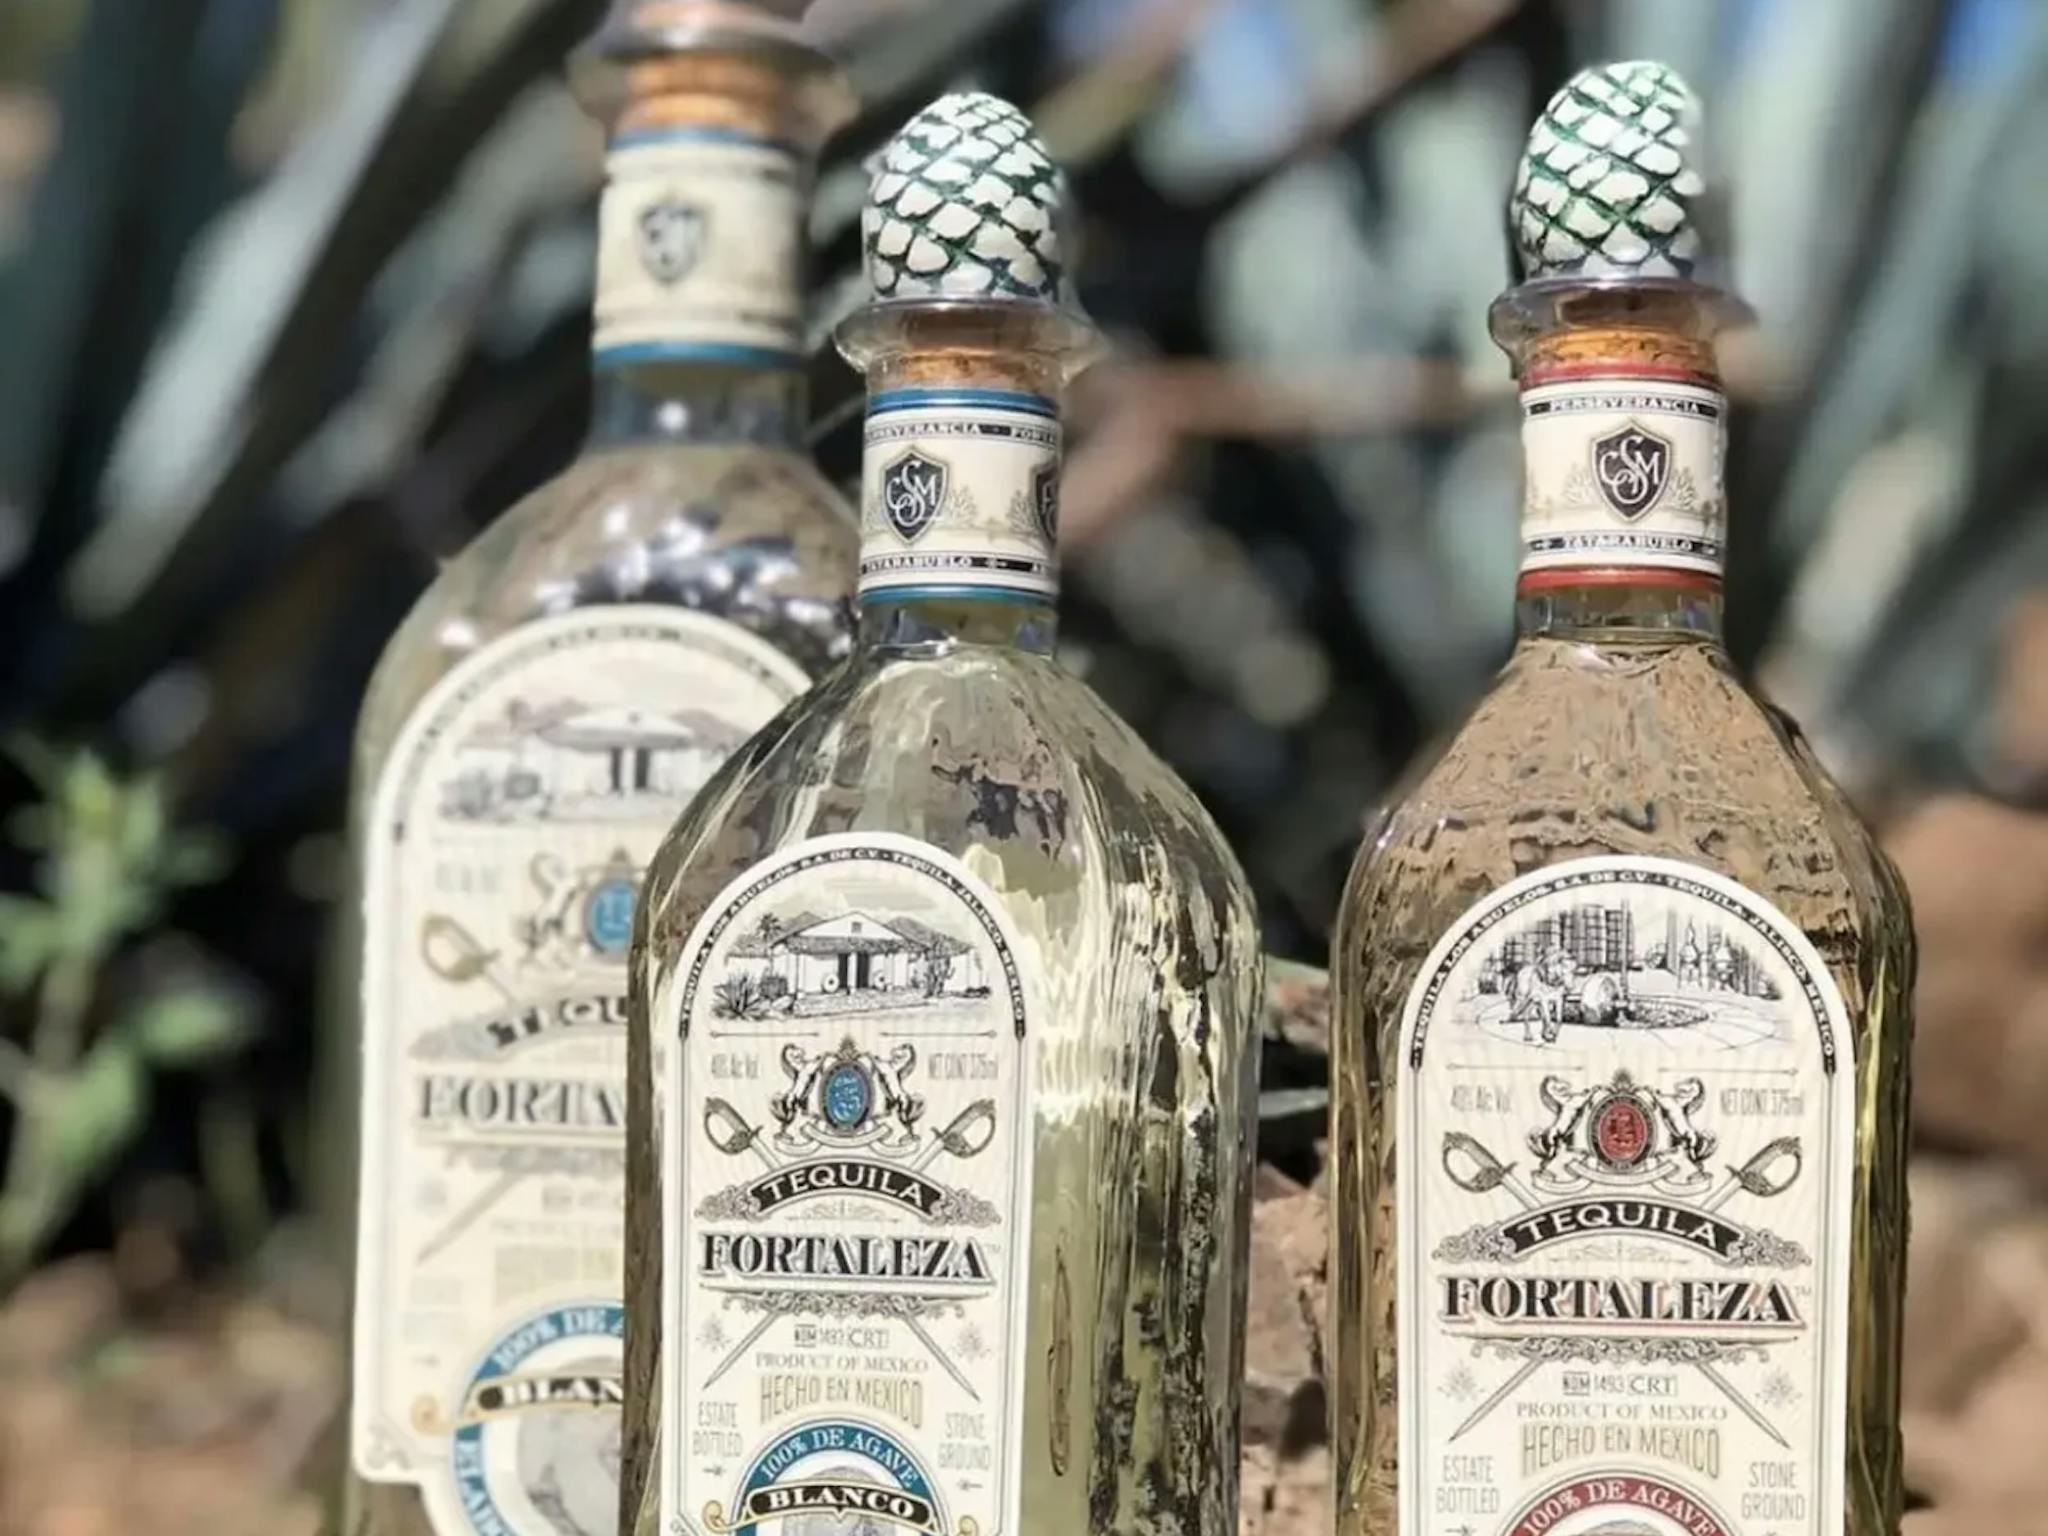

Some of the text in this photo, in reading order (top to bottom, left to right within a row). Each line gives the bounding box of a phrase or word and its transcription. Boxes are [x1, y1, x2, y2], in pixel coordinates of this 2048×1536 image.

[1414, 971, 1447, 1051] TEQUILA
[1444, 938, 1471, 969] LOS
[1589, 870, 1617, 884] DE
[763, 1164, 924, 1207] TEQUILA
[1517, 1203, 1719, 1252] TEQUILA
[701, 1233, 993, 1281] FORTALEZA
[1442, 1276, 1804, 1328] FORTALEZA
[756, 1354, 929, 1373] PRODUCT OF MEXICO
[1629, 1374, 1674, 1395] CRT
[759, 1376, 924, 1430] HECHO EN MEXICO
[1516, 1402, 1728, 1422] PRODUCT OF MEXICO
[762, 1428, 920, 1487] 100% DE AGAVE
[1442, 1456, 1494, 1484] ESTATE
[1522, 1424, 1721, 1480] HECHO EN MEXICO
[1748, 1462, 1798, 1489] STONE
[769, 1484, 914, 1519] BLANCO
[1436, 1487, 1499, 1515] BOTTLED
[1523, 1479, 1717, 1536] 100% DE AGAVE
[1741, 1493, 1805, 1521] GROUND
